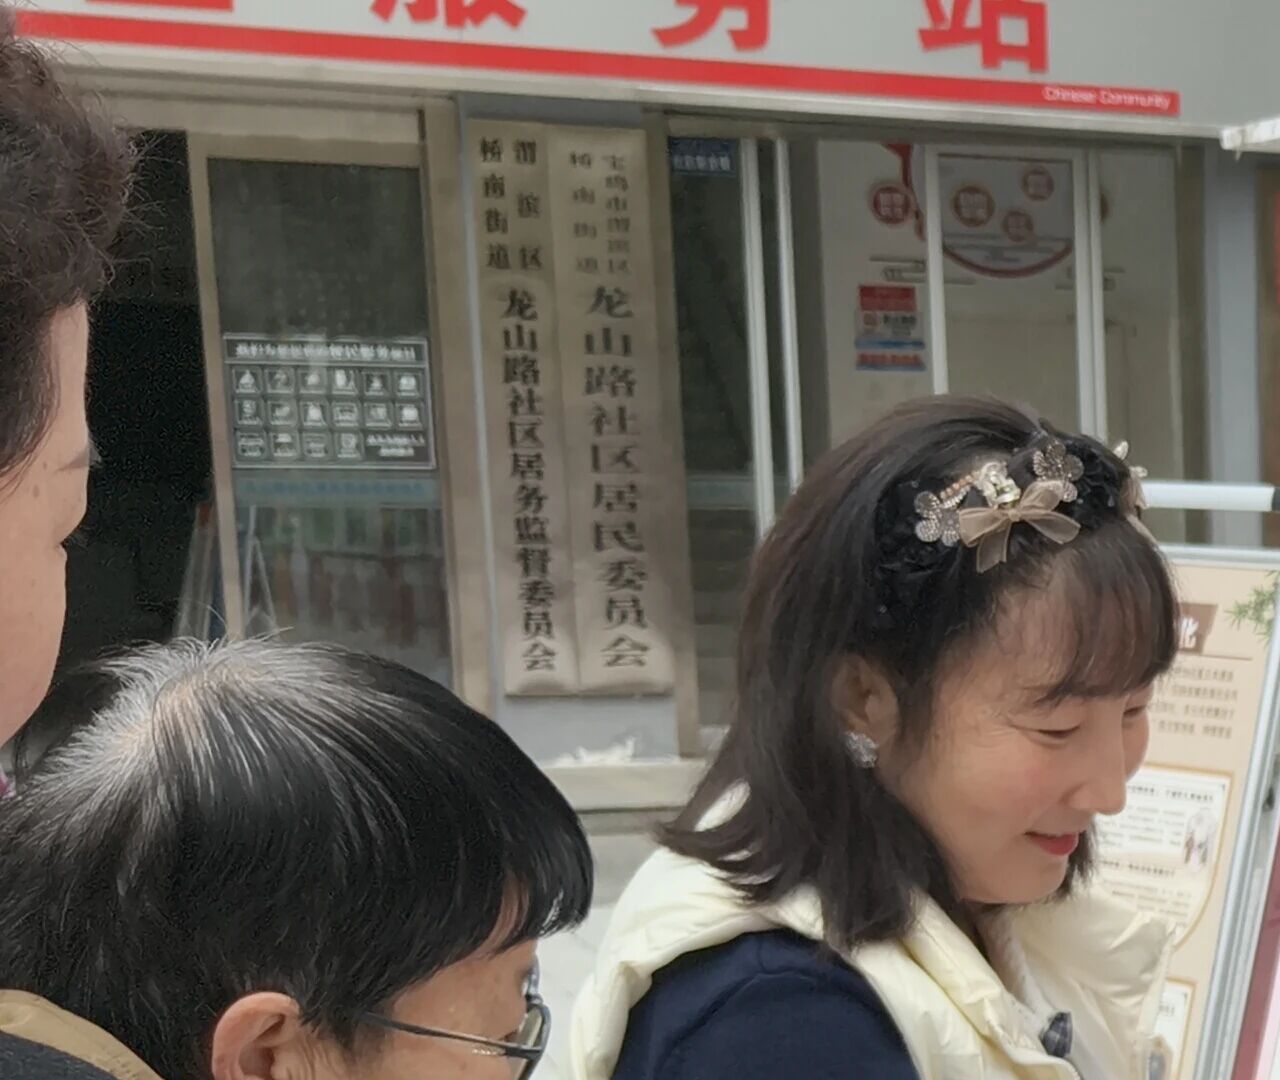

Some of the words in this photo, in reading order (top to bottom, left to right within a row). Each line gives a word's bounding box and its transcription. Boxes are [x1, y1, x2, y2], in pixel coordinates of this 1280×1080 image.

[584, 285, 649, 668] 龙山路社区居民委员会
